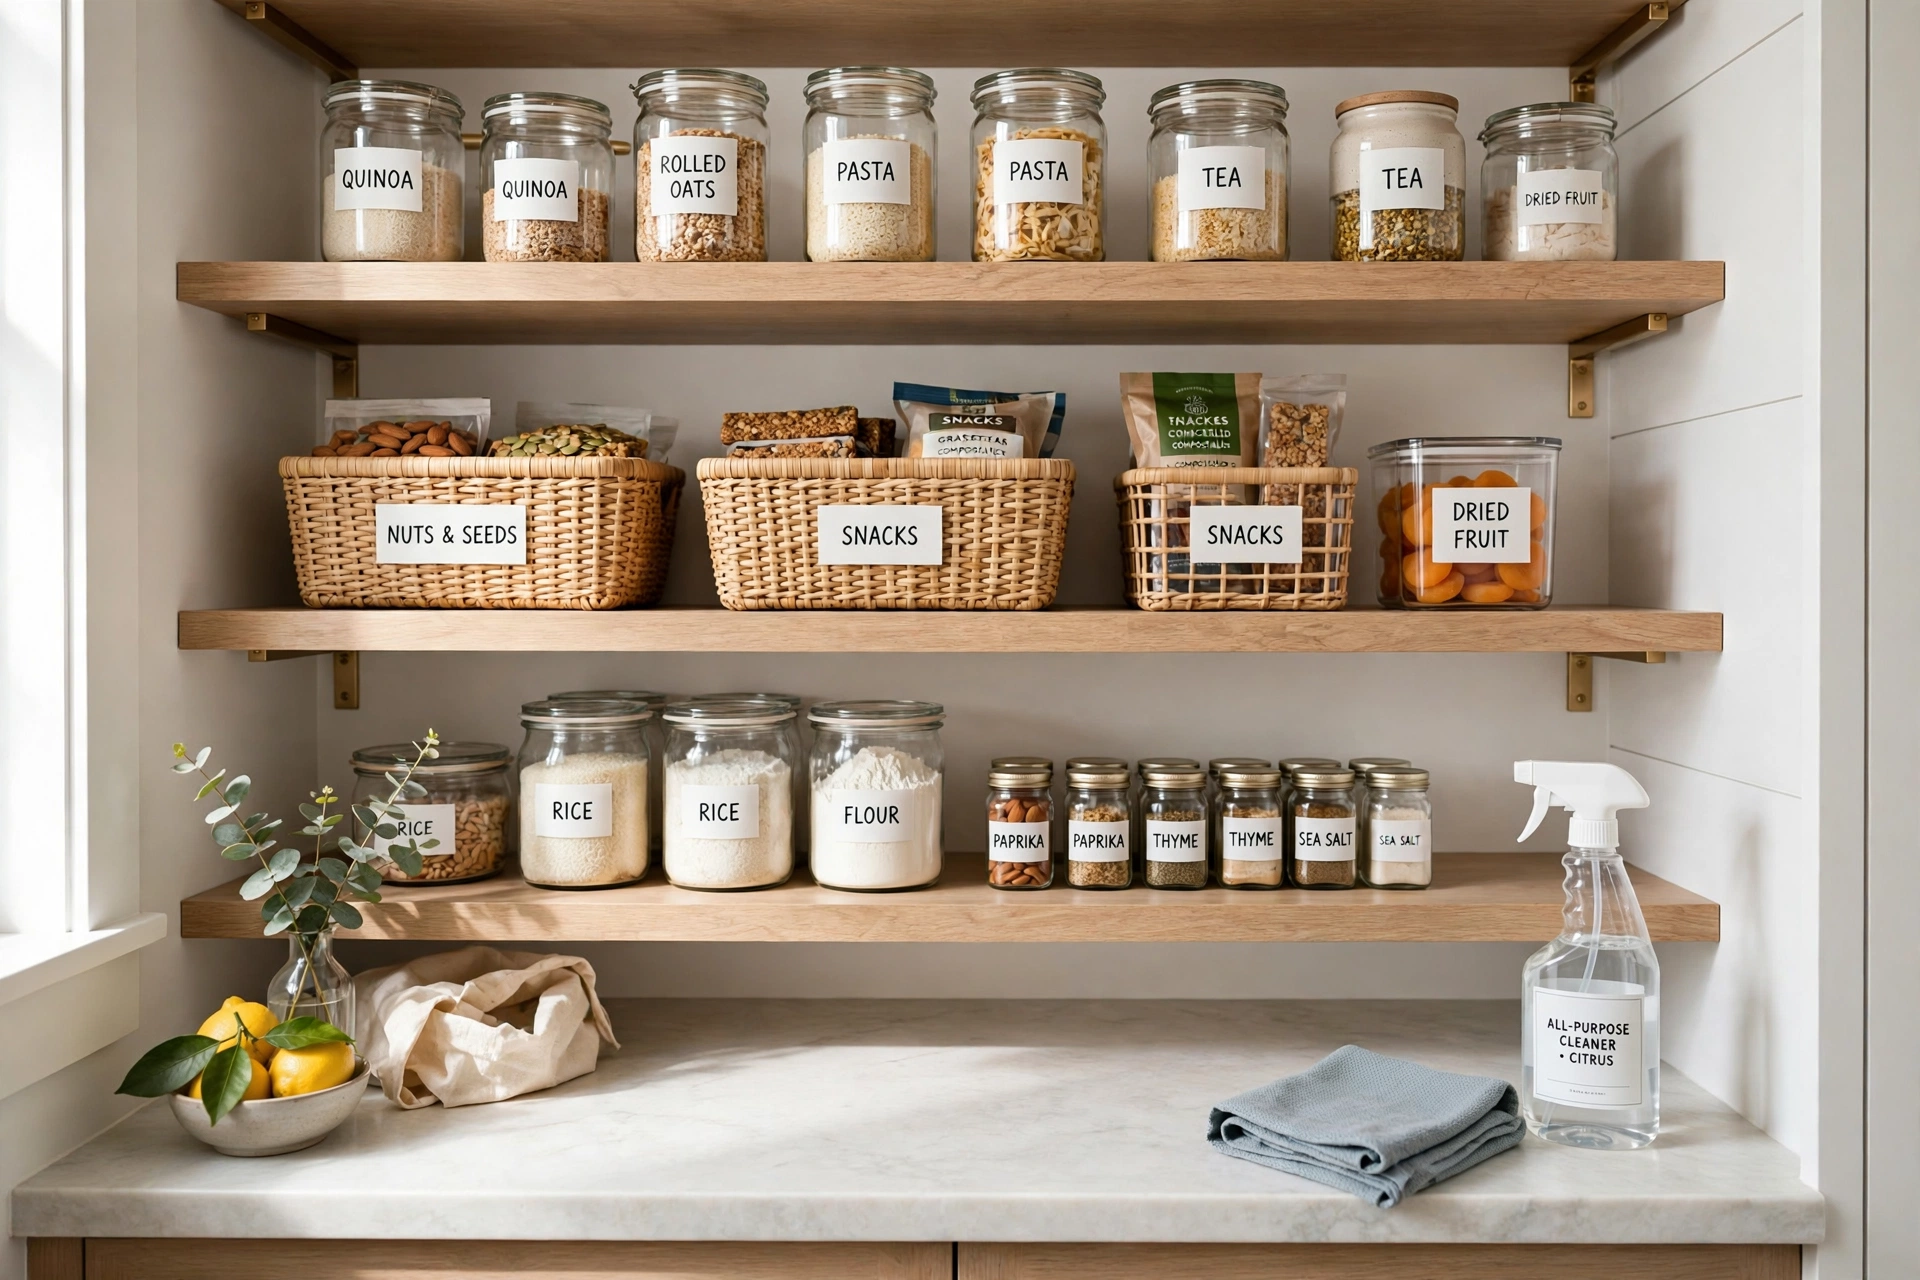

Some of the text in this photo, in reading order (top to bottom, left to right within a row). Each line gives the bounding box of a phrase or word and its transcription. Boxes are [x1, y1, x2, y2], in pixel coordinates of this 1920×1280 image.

[660, 153, 727, 175] ROLLED
[836, 159, 896, 183] PASTA
[1009, 159, 1069, 183] PASTA
[341, 167, 415, 191] QUINOA
[1200, 166, 1243, 189] TEA
[1380, 166, 1424, 191] TEA
[501, 178, 569, 201] QUINOA
[669, 179, 717, 200] OATS
[1524, 190, 1600, 208] DRIED FRUIT
[941, 415, 1003, 426] SNACKS
[1452, 501, 1511, 522] DRIED
[386, 524, 518, 545] NUTS & SEEDS
[841, 524, 919, 547] SNACKS
[1206, 523, 1284, 546] SNACKS
[1454, 528, 1510, 550] FRUIT
[552, 800, 594, 821] RICE
[698, 801, 741, 822] RICE
[843, 804, 901, 825] FLOUR
[397, 819, 434, 837] RICE
[993, 832, 1045, 850] PAPRIKA
[1072, 832, 1126, 849] PAPRIKA
[1152, 832, 1199, 850] THYME
[1229, 830, 1275, 848] THYME
[1298, 830, 1354, 848] SEA SALT
[1378, 833, 1422, 847] SEA SALT
[1546, 1016, 1631, 1036] ALL-PURPOSE
[1558, 1034, 1617, 1052] CLEANER
[1568, 1051, 1615, 1067] CITRUS
